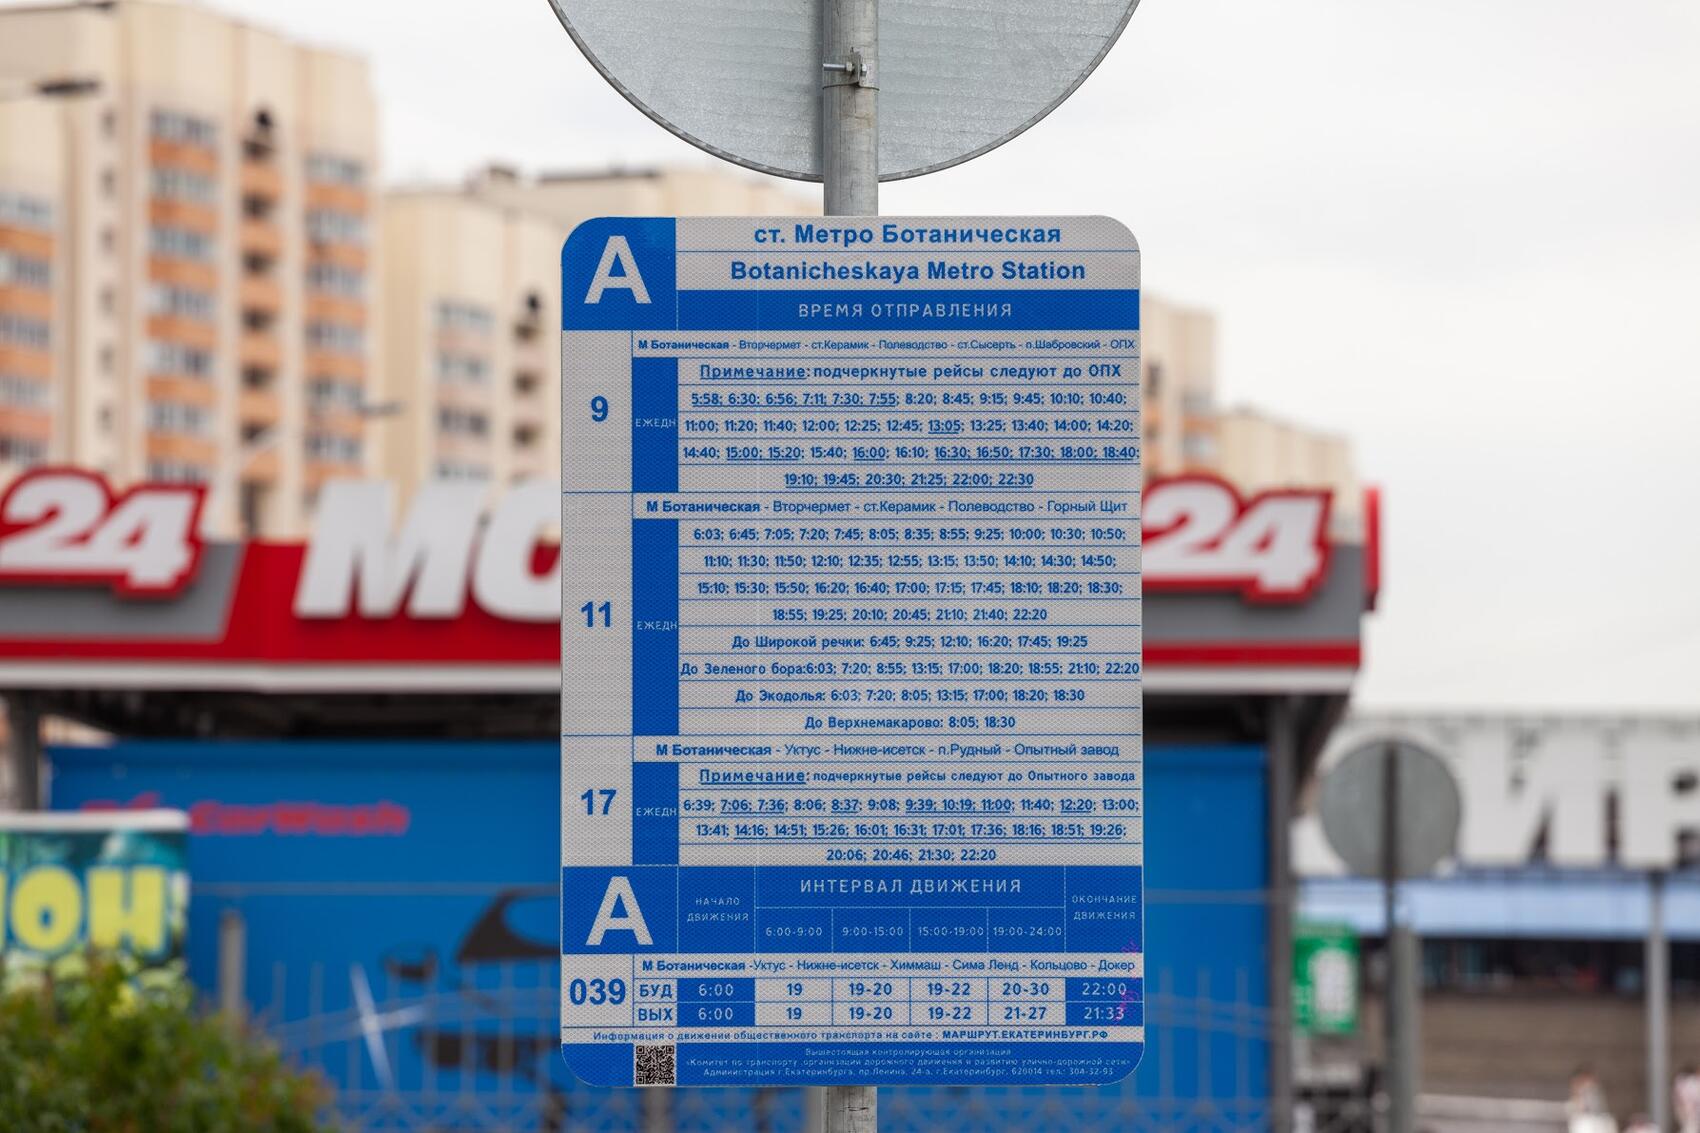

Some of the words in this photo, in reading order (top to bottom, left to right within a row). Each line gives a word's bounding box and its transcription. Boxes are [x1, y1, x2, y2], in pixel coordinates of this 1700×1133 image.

[754, 228, 784, 244] ст.
[795, 224, 874, 248] Метро
[881, 224, 1061, 244] Ботаническая
[730, 260, 920, 284] Botanicheskaya
[927, 260, 994, 280] Metro
[1002, 260, 1085, 280] Station
[799, 304, 862, 317] ВРЕМЯ
[871, 304, 1011, 317] ОТПРАВЛЕНИЯ
[638, 340, 648, 349] М
[651, 340, 729, 349] Ботаническая
[739, 340, 801, 351] Вторчермет
[811, 340, 869, 351] ст.Керамик
[879, 340, 948, 351] Полеводство
[957, 340, 1016, 351] ст.Сысерть
[1025, 339, 1101, 351] п.Шабровский
[1110, 340, 1135, 349] ОПХ
[811, 367, 927, 379] подчеркнутые
[932, 365, 984, 379] рейсы
[989, 367, 1057, 379] следуют
[1062, 367, 1082, 378] до
[1088, 364, 1120, 378] ОПХ
[691, 393, 723, 405] 5:58;
[728, 393, 760, 405] 6:30;
[765, 393, 797, 405] 6:56;
[802, 393, 827, 405] 7:11;
[833, 393, 863, 405] 7:30;
[869, 393, 899, 405] 7:55;
[905, 393, 936, 405] 8:20;
[942, 393, 973, 405] 8:45;
[979, 393, 1007, 405] 9:15;
[1013, 393, 1044, 405] 9:45;
[1050, 393, 1084, 405] 10:10;
[1090, 393, 1127, 405] 10:40;
[591, 395, 608, 422] 9
[636, 418, 676, 428] ЕЖЕДН
[785, 473, 817, 485] 19:10;
[824, 473, 861, 485] 19:45;
[864, 473, 904, 485] 20:30;
[910, 473, 947, 485] 21:25;
[952, 473, 992, 485] 22:00;
[997, 473, 1034, 485] 22:30
[646, 501, 658, 512] М
[662, 501, 760, 512] Ботаническая
[773, 501, 850, 514] Вторчермет
[863, 501, 936, 514] ст.Керамик
[948, 501, 1034, 514] Полеводство
[1047, 500, 1096, 514] Горный
[1100, 501, 1127, 514] Щит
[0, 471, 203, 589] 24
[1142, 479, 1329, 595] 24
[580, 601, 611, 628] 11
[773, 608, 806, 621] 18:55;
[813, 608, 847, 621] 19:25;
[853, 608, 887, 621] 20:10;
[893, 608, 929, 621] 20:45;
[936, 608, 966, 621] 21:10;
[973, 608, 1007, 621] 21:40;
[1013, 608, 1047, 621] 22:20
[637, 621, 677, 631] ЕЖЕДН
[732, 635, 749, 649] До
[755, 636, 816, 649] Широкой
[820, 639, 863, 649] речки:
[869, 635, 900, 648] 6:45;
[905, 635, 935, 648] 9:25;
[940, 635, 972, 648] 12:10;
[977, 635, 1011, 648] 16:20;
[1017, 635, 1053, 648] 17:45;
[1056, 635, 1088, 648] 19:25
[680, 661, 698, 678] До
[704, 663, 766, 674] Зеленого
[843, 662, 871, 674] 7:20;
[876, 662, 907, 674] 8:55;
[912, 662, 944, 674] 13:15;
[949, 662, 983, 674] 17:00;
[987, 662, 1024, 674] 18:20;
[1028, 662, 1062, 674] 18:55;
[1067, 662, 1100, 674] 21:10;
[1104, 662, 1140, 674] 22:20
[804, 716, 823, 729] До
[828, 716, 943, 730] Верхнемакарово:
[948, 716, 979, 728] 8:05;
[984, 716, 1016, 728] 18:30
[656, 744, 667, 755] М
[672, 744, 771, 755] Ботаническая
[784, 744, 821, 757] Уктус
[833, 743, 926, 755] Нижне-исетск
[938, 743, 1001, 757] п.Рудный
[1014, 743, 1076, 755] Опытный
[1081, 747, 1119, 757] завод
[811, 772, 903, 782] подчеркнутые
[905, 770, 948, 782] рейсы
[950, 772, 1002, 782] следуют
[1008, 773, 1024, 782] до
[1027, 770, 1088, 782] Опытного
[1093, 772, 1136, 782] завода
[581, 788, 617, 816] 17
[636, 807, 677, 817] ЕЖЕДН
[827, 848, 867, 862] 20:06;
[873, 848, 912, 862] 20:46;
[919, 848, 954, 862] 21:30;
[961, 848, 996, 862] 22:20
[801, 879, 901, 893] ИНТЕРВАЛ
[910, 879, 1020, 894] ДВИЖЕНИЯ
[696, 897, 739, 905] НАЧАЛО
[1072, 895, 1136, 903] ОКОНЧАНИЕ
[687, 913, 748, 922] ДВИЖЕНИЯ
[1074, 912, 1135, 920] ДВИЖЕНИЯ
[766, 927, 822, 936] 6:00-9:00
[843, 927, 903, 936] 9:00-15:00
[918, 927, 983, 936] 15:00-19:00
[993, 927, 1061, 936] 19:00-24:00
[642, 961, 652, 970] М
[656, 961, 745, 970] Ботаническая
[797, 961, 879, 970] Нижне-исетск
[890, 961, 941, 970] Химмаш
[952, 961, 985, 970] Сима
[988, 960, 1019, 972] Ленд
[1030, 960, 1087, 972] Кольцово
[1098, 960, 1135, 972] Докер
[569, 977, 626, 1006] 039
[639, 984, 672, 998] БУД
[698, 984, 733, 996] 6:00
[786, 982, 804, 997] 19
[849, 982, 893, 997] 19-20
[928, 982, 971, 997] 19-22
[1002, 981, 1050, 997] 20-30
[1082, 982, 1127, 996] 22:00
[638, 1008, 672, 1022] ВЫХ
[698, 1007, 733, 1020] 6:00
[787, 1006, 803, 1021] 19
[849, 1006, 893, 1022] 19-20
[929, 1006, 972, 1021] 19-22
[1004, 1005, 1047, 1022] 21-27
[593, 1031, 665, 1040] Информация
[677, 1033, 730, 1041] движении
[734, 1031, 817, 1040] общественного
[821, 1033, 883, 1041] транспорта
[902, 1031, 932, 1039] сайте
[942, 1030, 1108, 1040] МАРШРУТ.ЕКАТЕРИНБУРГ.РФ
